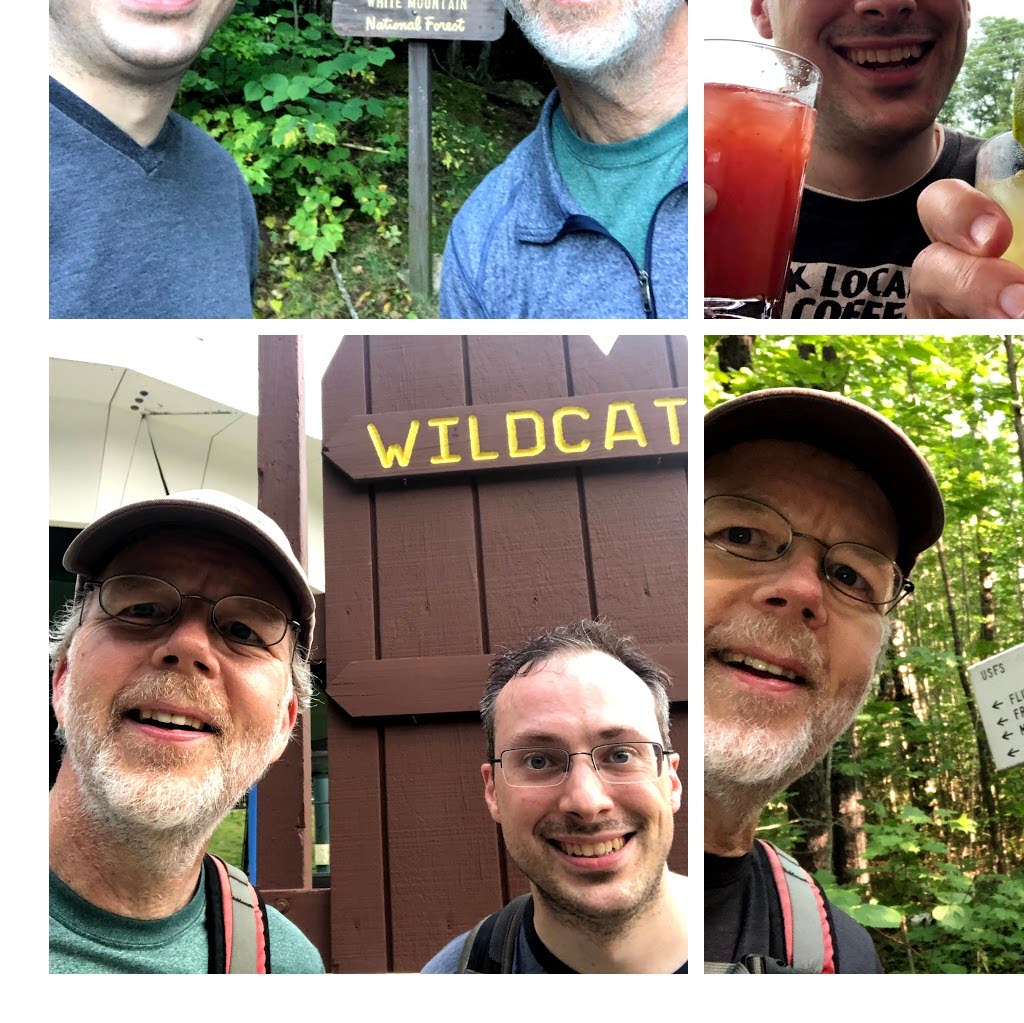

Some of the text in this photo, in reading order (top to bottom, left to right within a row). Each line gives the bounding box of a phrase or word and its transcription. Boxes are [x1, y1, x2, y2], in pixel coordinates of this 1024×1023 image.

[365, 15, 466, 32] National Forest
[820, 266, 911, 299] LOCA
[367, 397, 688, 469] WILDCAT
[980, 663, 1006, 682] USFS
